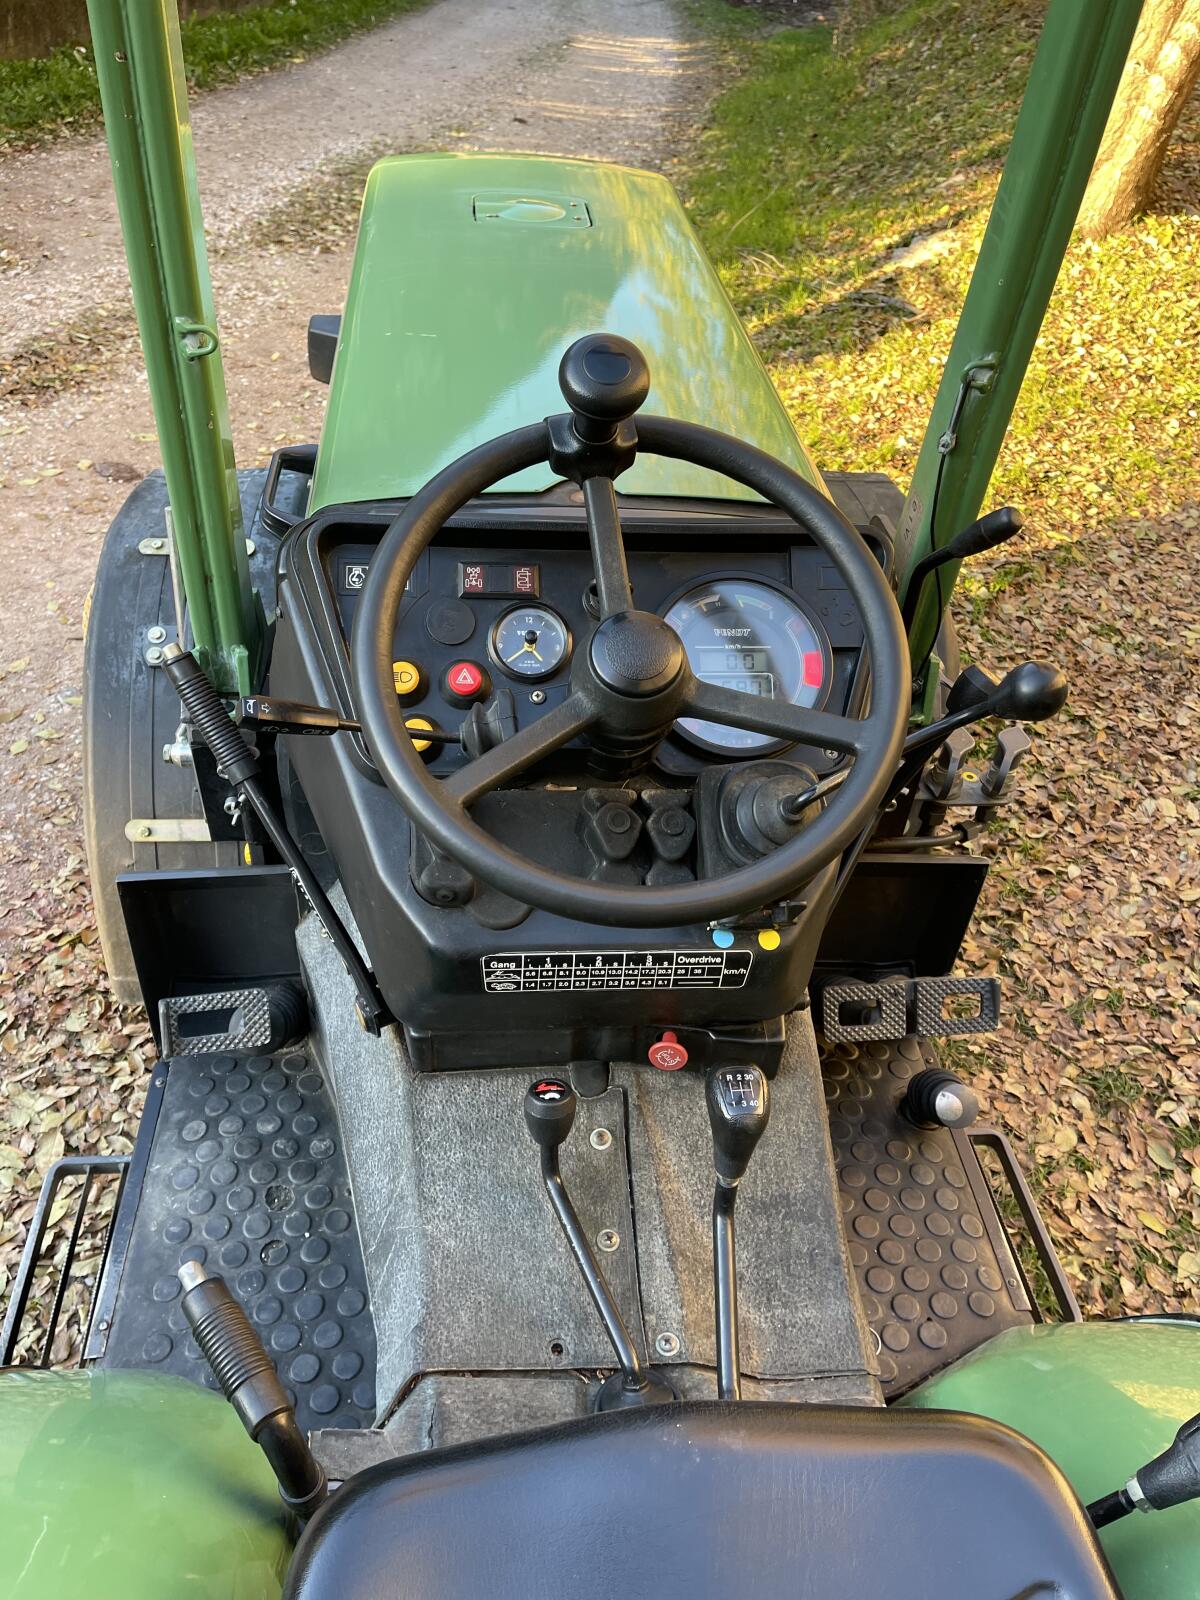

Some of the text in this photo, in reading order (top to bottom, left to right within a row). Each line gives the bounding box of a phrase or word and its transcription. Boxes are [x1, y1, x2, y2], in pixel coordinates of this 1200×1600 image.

[713, 628, 751, 637] FENDT
[677, 955, 722, 964] Overdrive
[490, 961, 516, 969] Gang
